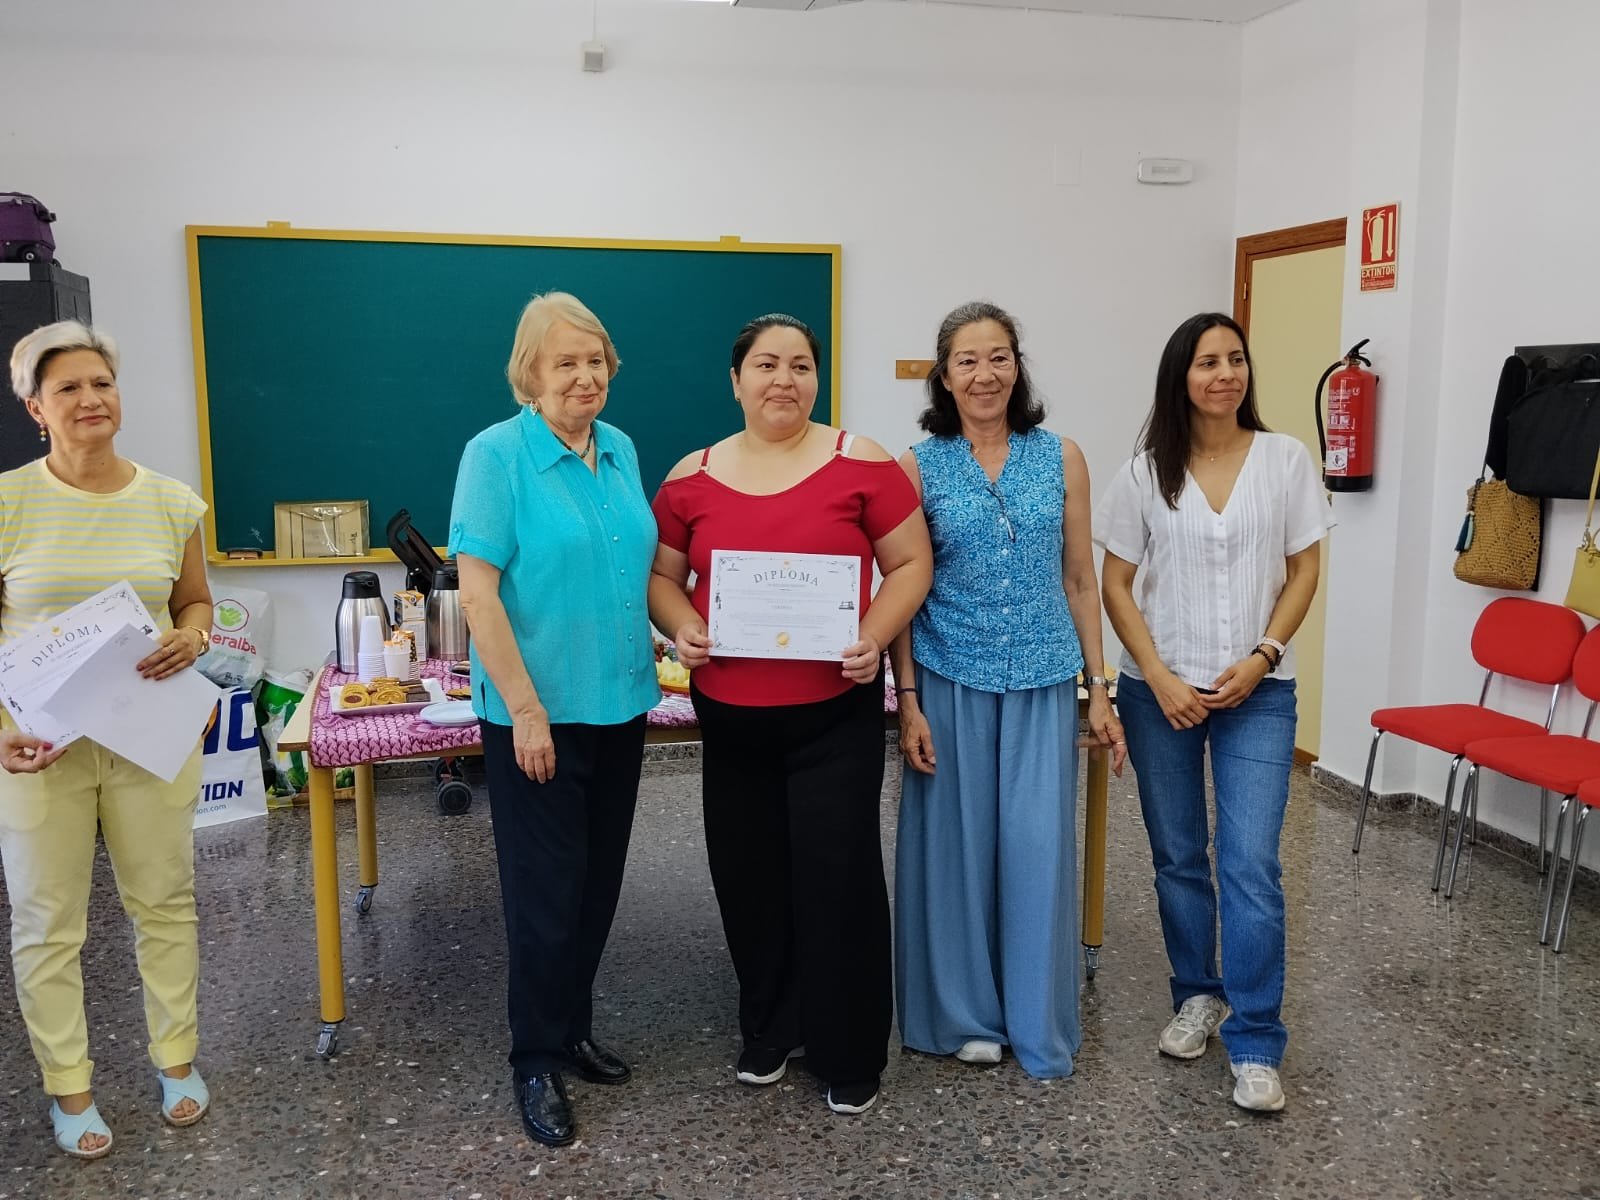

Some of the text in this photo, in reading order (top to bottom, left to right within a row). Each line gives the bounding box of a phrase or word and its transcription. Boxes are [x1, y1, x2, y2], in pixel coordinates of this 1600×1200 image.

[1362, 265, 1395, 278] EXTINTOR
[753, 569, 819, 586] DIPLOMA
[31, 623, 103, 667] DIPLOMA
[211, 633, 257, 655] eralba
[202, 780, 244, 802] ION
[195, 803, 227, 816] ion.com
